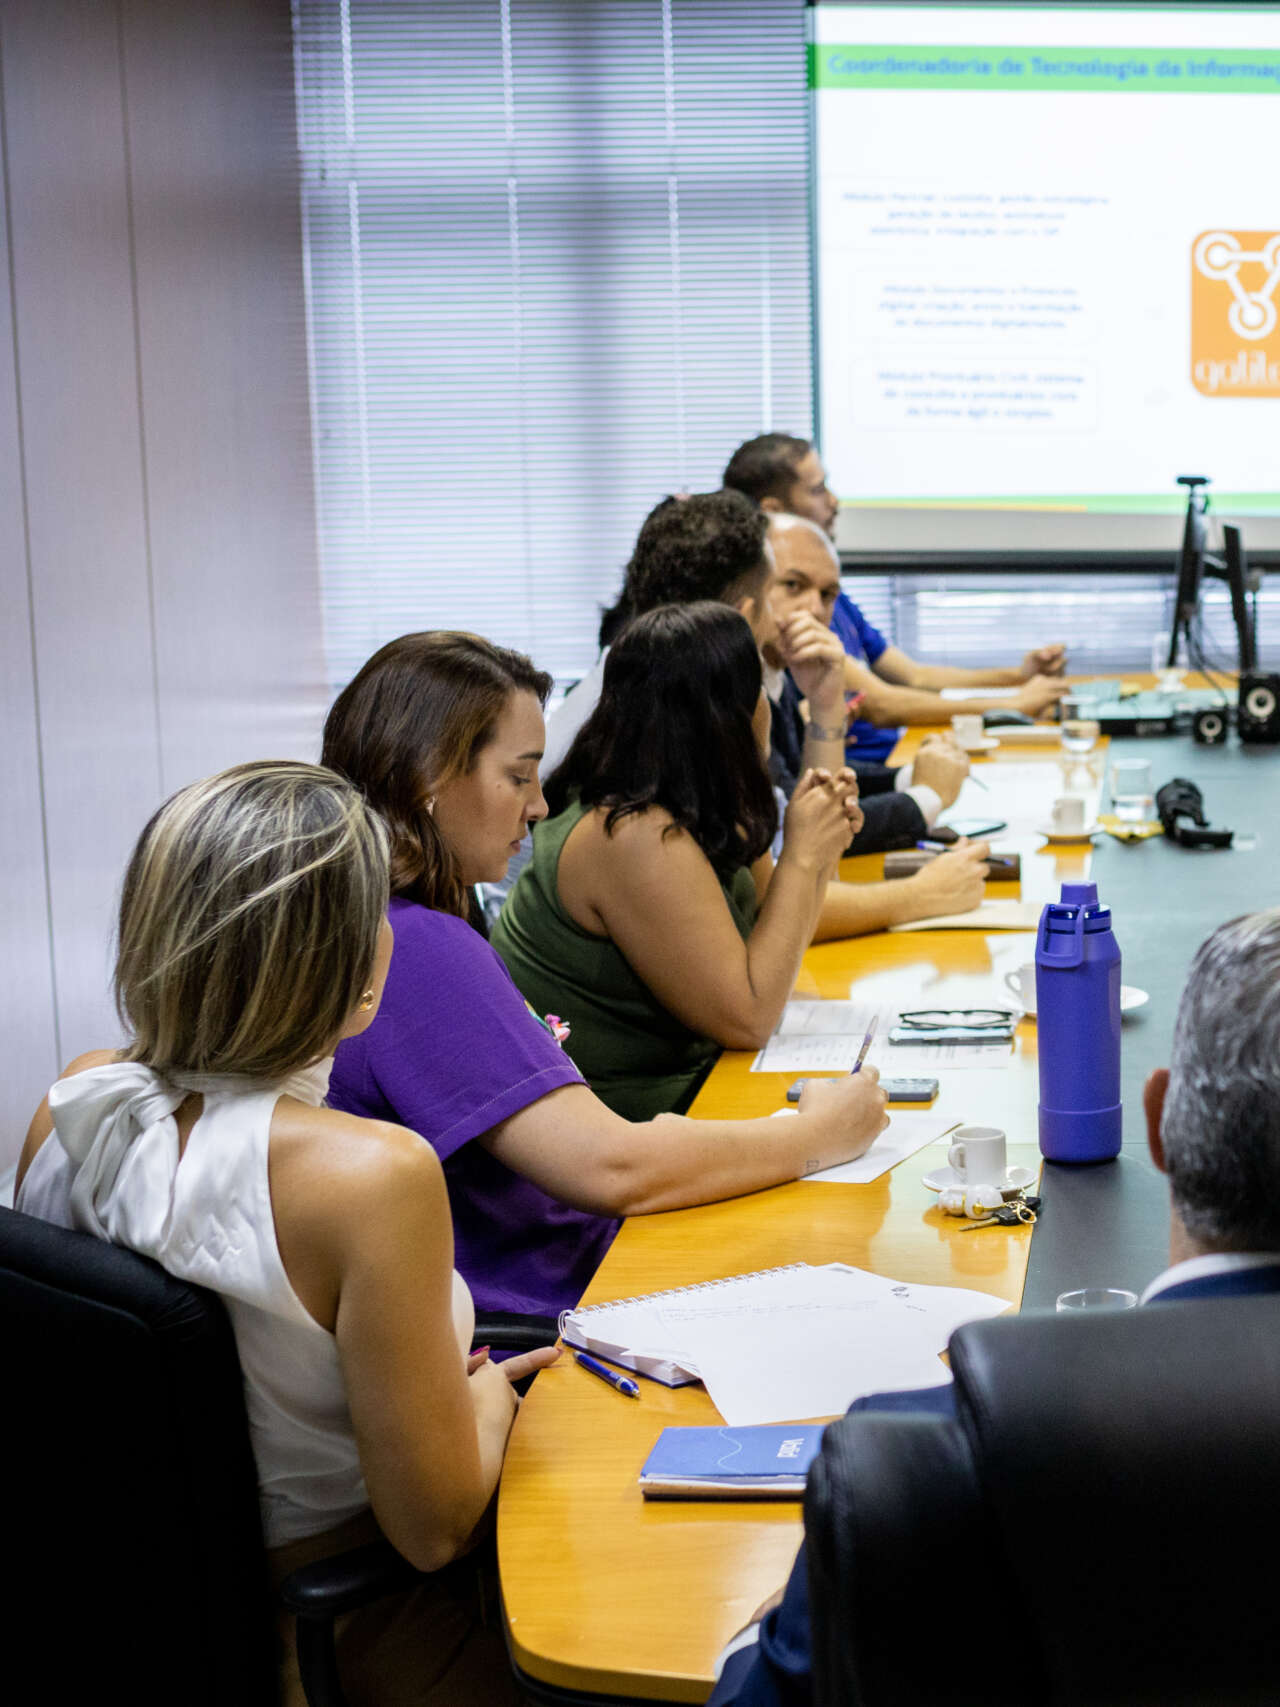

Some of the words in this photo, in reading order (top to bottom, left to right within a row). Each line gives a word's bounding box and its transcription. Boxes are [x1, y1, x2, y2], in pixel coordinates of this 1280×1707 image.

[827, 54, 992, 76] Coordenadoria
[997, 56, 1025, 76] de
[1030, 56, 1149, 82] Tecnologia
[1155, 59, 1181, 78] da
